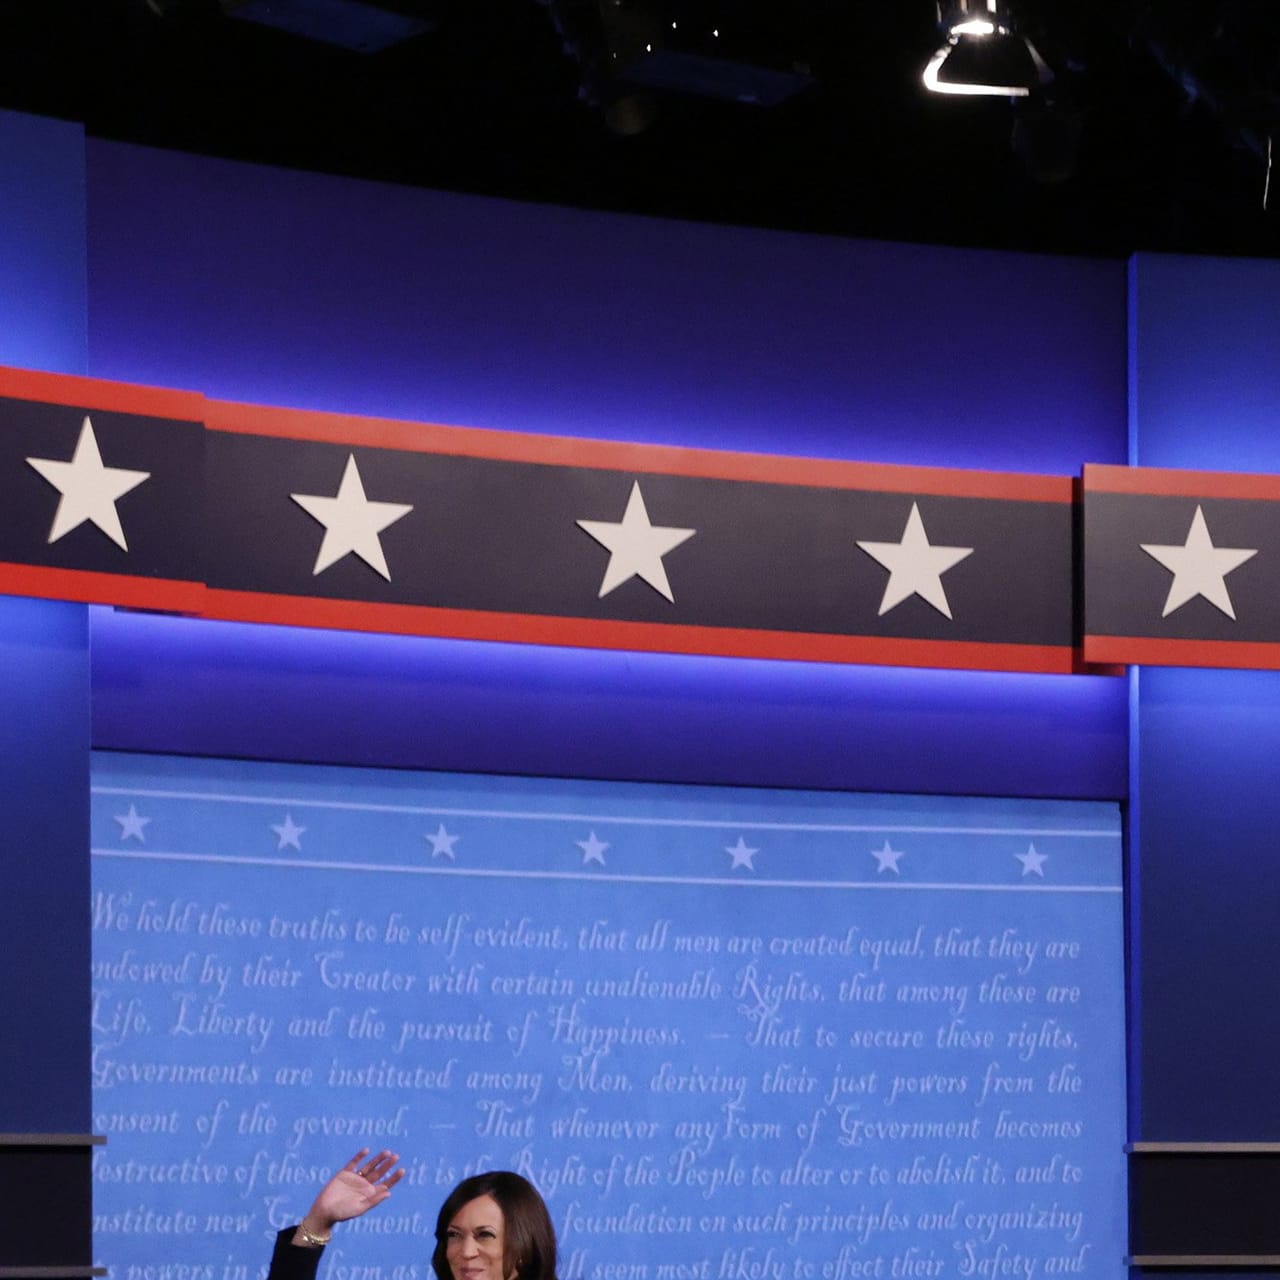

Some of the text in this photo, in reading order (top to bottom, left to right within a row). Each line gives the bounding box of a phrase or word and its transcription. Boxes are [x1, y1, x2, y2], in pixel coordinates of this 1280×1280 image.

[92, 891, 131, 931] We
[138, 899, 198, 934] hold
[200, 902, 262, 936] these
[269, 908, 347, 941] truths
[355, 919, 377, 941] to
[385, 912, 410, 945] be
[579, 919, 628, 950] that
[636, 919, 673, 950] all
[674, 934, 720, 952] men
[728, 935, 762, 954] are
[770, 926, 859, 957] created
[934, 927, 980, 957] that
[989, 928, 1039, 975] they
[1046, 938, 1080, 959] are
[201, 953, 233, 1002] by
[243, 955, 302, 988] their
[428, 962, 486, 993] with
[491, 970, 574, 996] certain
[585, 966, 721, 999] unalienable
[839, 972, 887, 1002] that
[897, 982, 968, 1015] among
[978, 972, 1036, 1003] these
[1046, 982, 1081, 1003] are
[169, 992, 994, 1058] Liberty and the pursuit of to secure these
[274, 1066, 313, 1086] are
[328, 1057, 459, 1088] instituted
[466, 1070, 543, 1104] among
[650, 1063, 749, 1104] deriving
[761, 1063, 818, 1094] their
[825, 1063, 878, 1105] just
[883, 1072, 968, 1106] powers
[974, 1061, 1034, 1107] from
[1047, 1063, 1082, 1094] the
[196, 1099, 229, 1150] of
[237, 1101, 278, 1135] the
[475, 1099, 536, 1138] That
[551, 1107, 659, 1139] whenever
[674, 1120, 718, 1155] any
[720, 1101, 782, 1139] Form
[796, 1107, 827, 1157] of
[836, 1104, 981, 1146] Government
[995, 1109, 1083, 1138] becomes
[235, 1142, 1083, 1201] of these of the People to alter or to abolish and to
[204, 1200, 1083, 1249] new foundation on such principles and organizing
[655, 1259, 712, 1280] most
[792, 1257, 814, 1280] to
[891, 1247, 944, 1278] their
[1044, 1244, 1093, 1273] and
